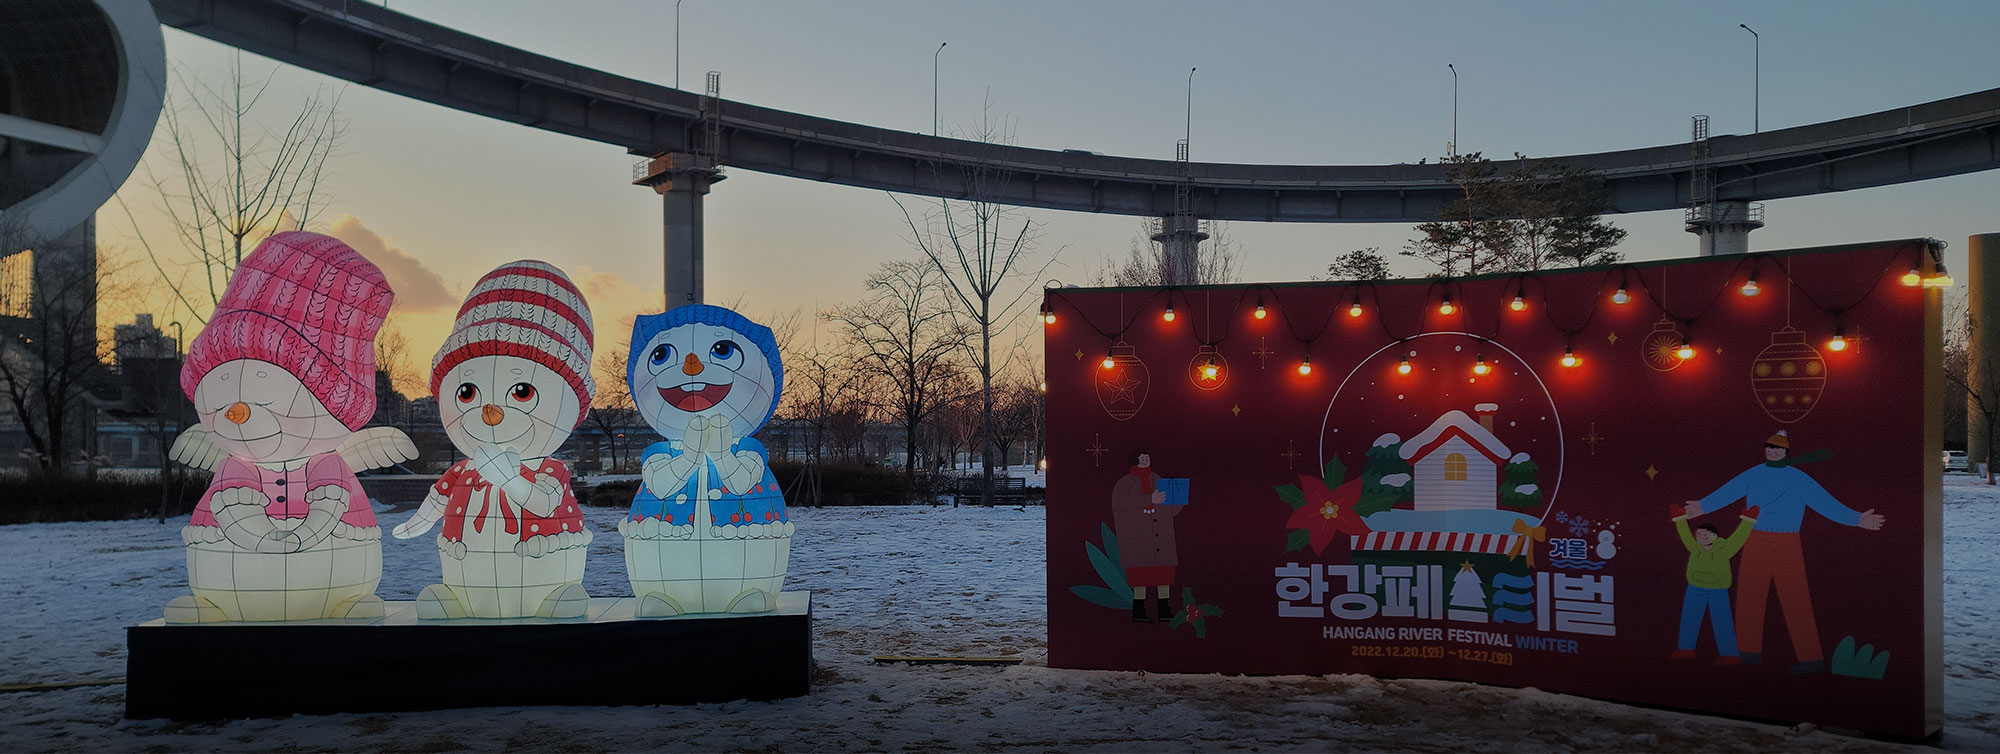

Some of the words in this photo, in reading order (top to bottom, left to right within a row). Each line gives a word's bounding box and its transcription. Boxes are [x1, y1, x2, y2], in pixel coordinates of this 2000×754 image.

[1548, 538, 1588, 560] 겨울
[1274, 561, 1617, 637] 한강페스티벌
[1322, 625, 1396, 641] HANGANG
[1398, 627, 1444, 642] RIVER
[1447, 629, 1513, 648] FESTIVAL
[1514, 634, 1580, 655] WINTER
